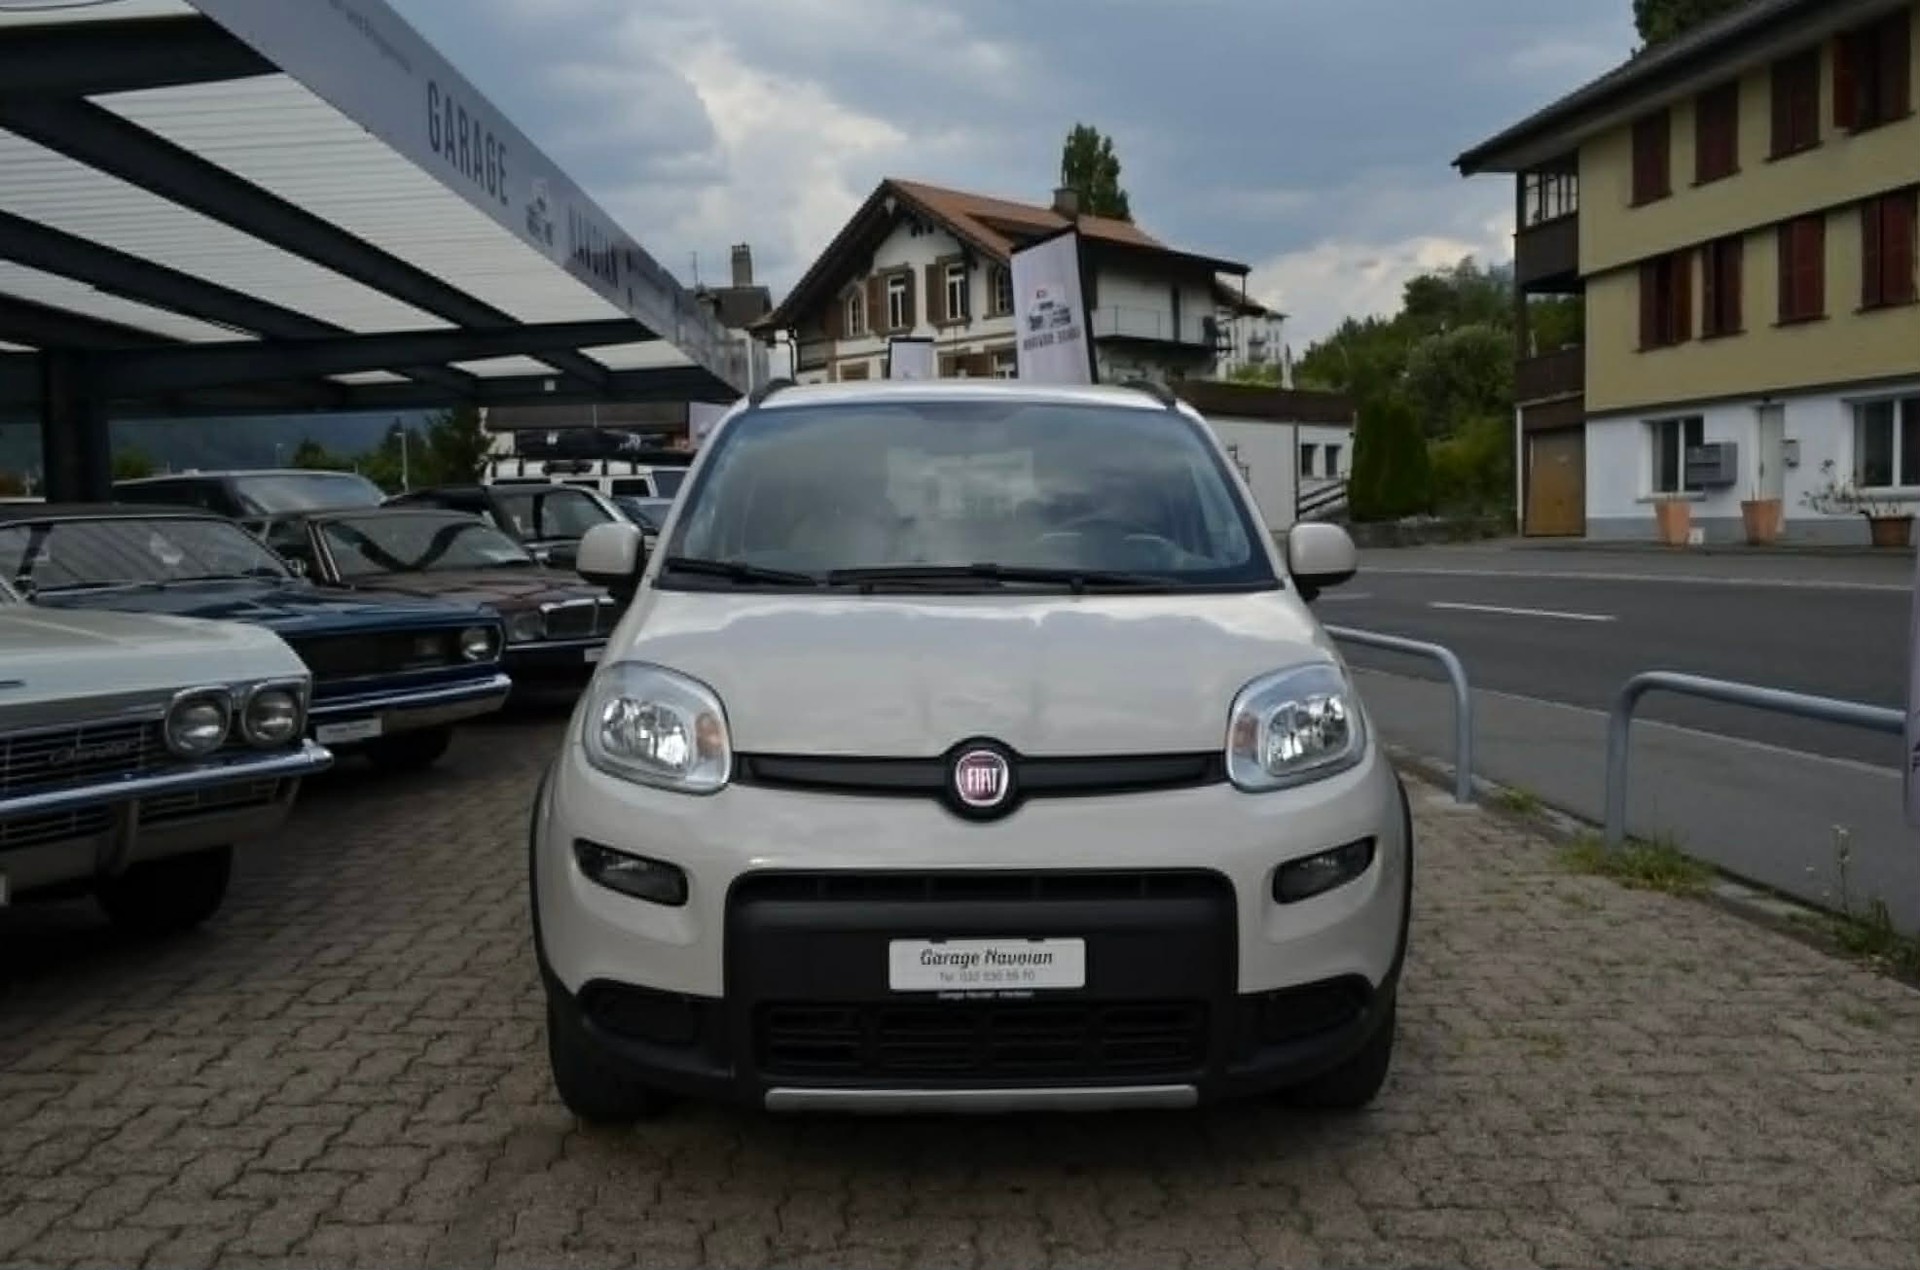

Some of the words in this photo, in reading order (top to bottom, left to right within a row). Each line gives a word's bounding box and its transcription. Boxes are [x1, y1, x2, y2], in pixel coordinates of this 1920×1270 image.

[427, 80, 509, 205] GARAGE
[967, 768, 999, 793] FIAT
[920, 948, 979, 969] Garage
